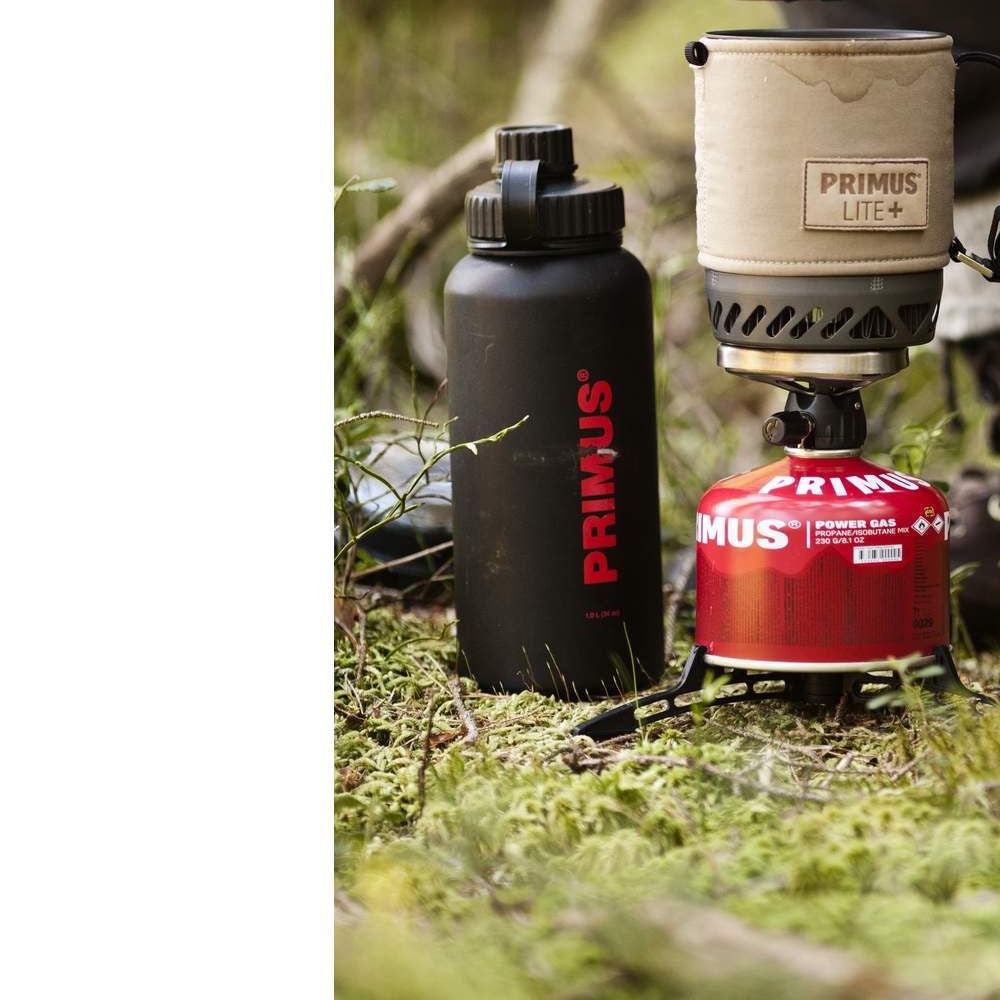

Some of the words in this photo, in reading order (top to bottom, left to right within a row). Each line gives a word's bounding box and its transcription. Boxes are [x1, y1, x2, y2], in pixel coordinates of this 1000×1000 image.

[815, 520, 866, 530] POWER
[870, 519, 896, 528] GAS
[815, 528, 895, 537] PROPANE/ISOBUTANE
